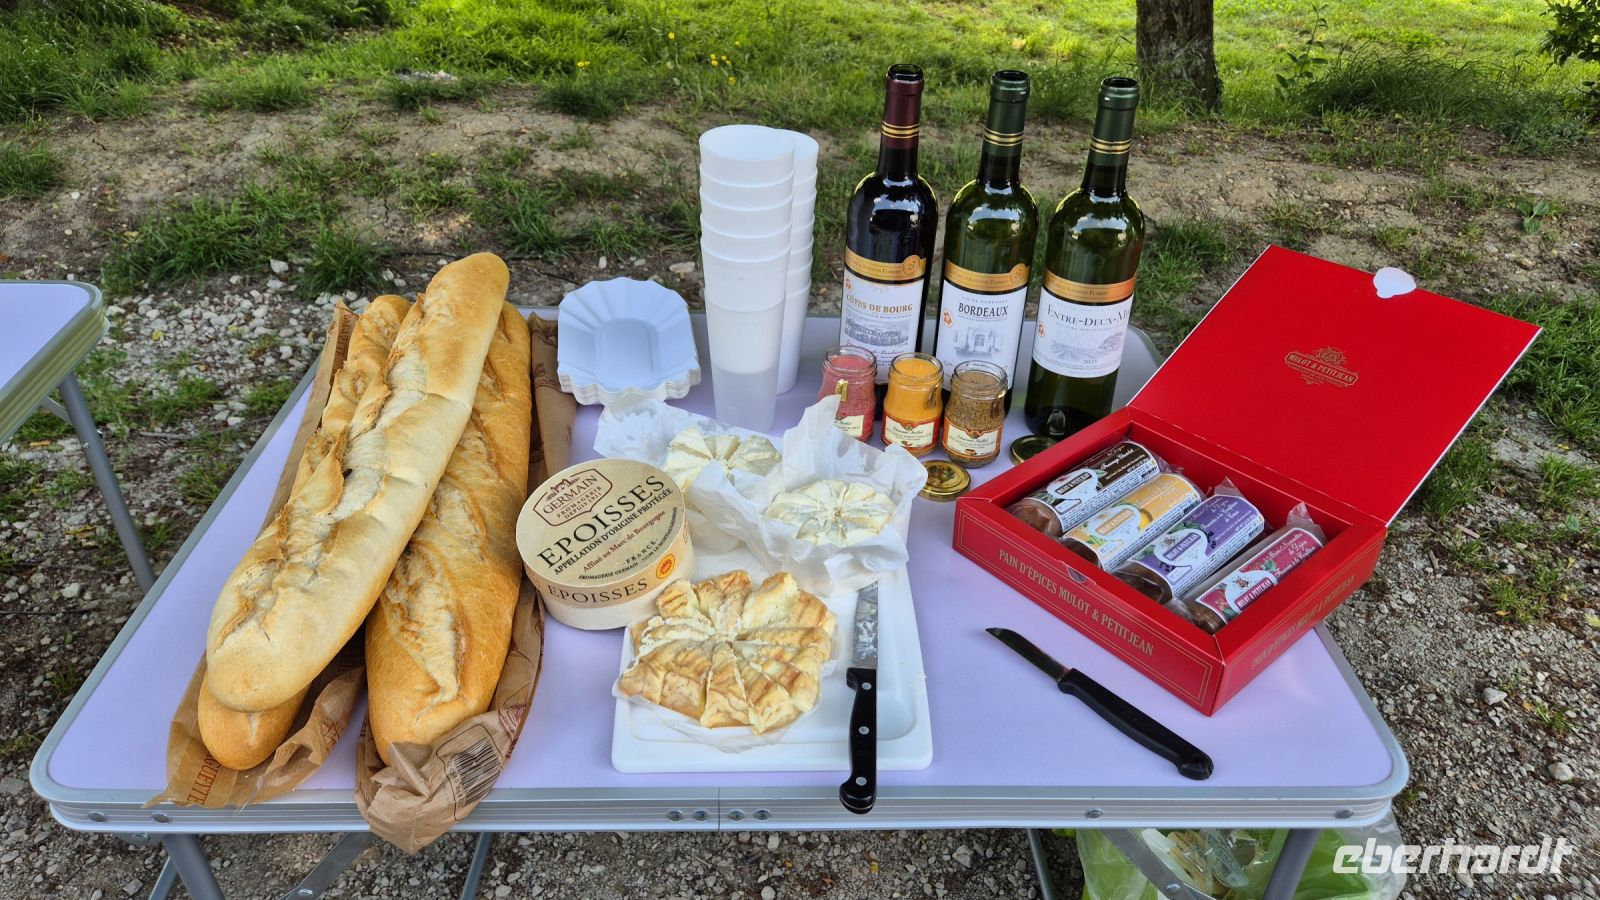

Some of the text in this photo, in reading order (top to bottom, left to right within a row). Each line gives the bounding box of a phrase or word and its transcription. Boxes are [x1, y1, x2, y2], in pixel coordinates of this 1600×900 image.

[869, 303, 881, 312] DE
[883, 303, 913, 313] BOURG
[958, 302, 1009, 317] BORDEAUX
[1287, 354, 1312, 367] MULOT
[1317, 364, 1354, 382] PETITJEAN
[543, 475, 598, 513] GERMAIN
[557, 486, 602, 518] FROMAGERIE
[537, 475, 664, 568] EPOISSES
[564, 502, 587, 519] DEPUIS
[554, 487, 673, 575] APPELLATION D'ORIGINE PROTÉGÉE
[583, 554, 603, 572] Affiné
[602, 550, 612, 560] au
[610, 539, 627, 554] Marc
[626, 531, 636, 541] de
[633, 511, 666, 535] Bourgogne
[626, 540, 656, 565] FRANCE
[578, 572, 614, 580] FROMAGERIE
[614, 562, 639, 575] GERMAIN
[547, 578, 648, 604] EPOISSES
[999, 549, 1154, 656] PAIN D'ÉPICES MULOT & PETITJEAN
